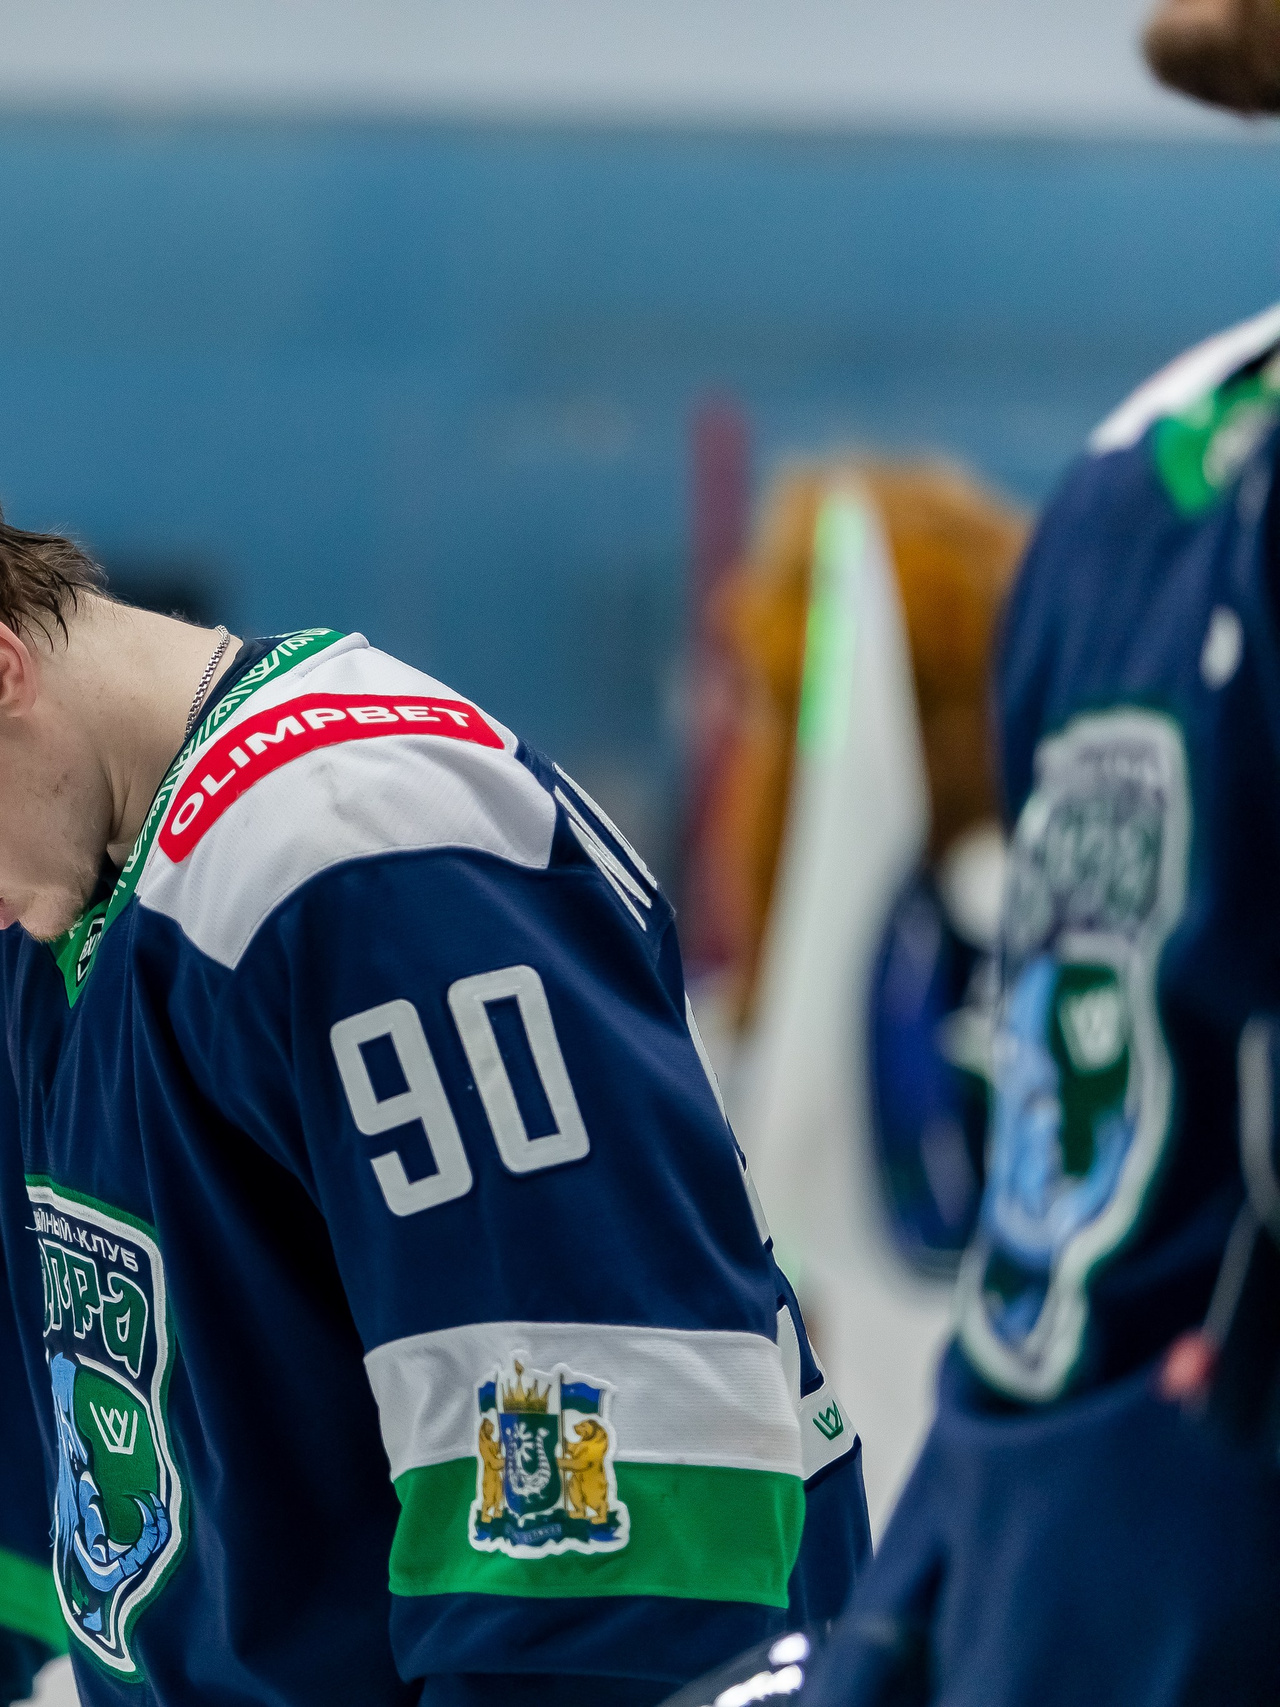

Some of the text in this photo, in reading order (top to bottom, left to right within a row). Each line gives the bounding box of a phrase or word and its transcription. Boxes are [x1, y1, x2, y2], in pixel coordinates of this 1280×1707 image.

[170, 704, 470, 836] OLIMPBET
[329, 964, 591, 1217] 90
[73, 1226, 139, 1272] КЛУБ
